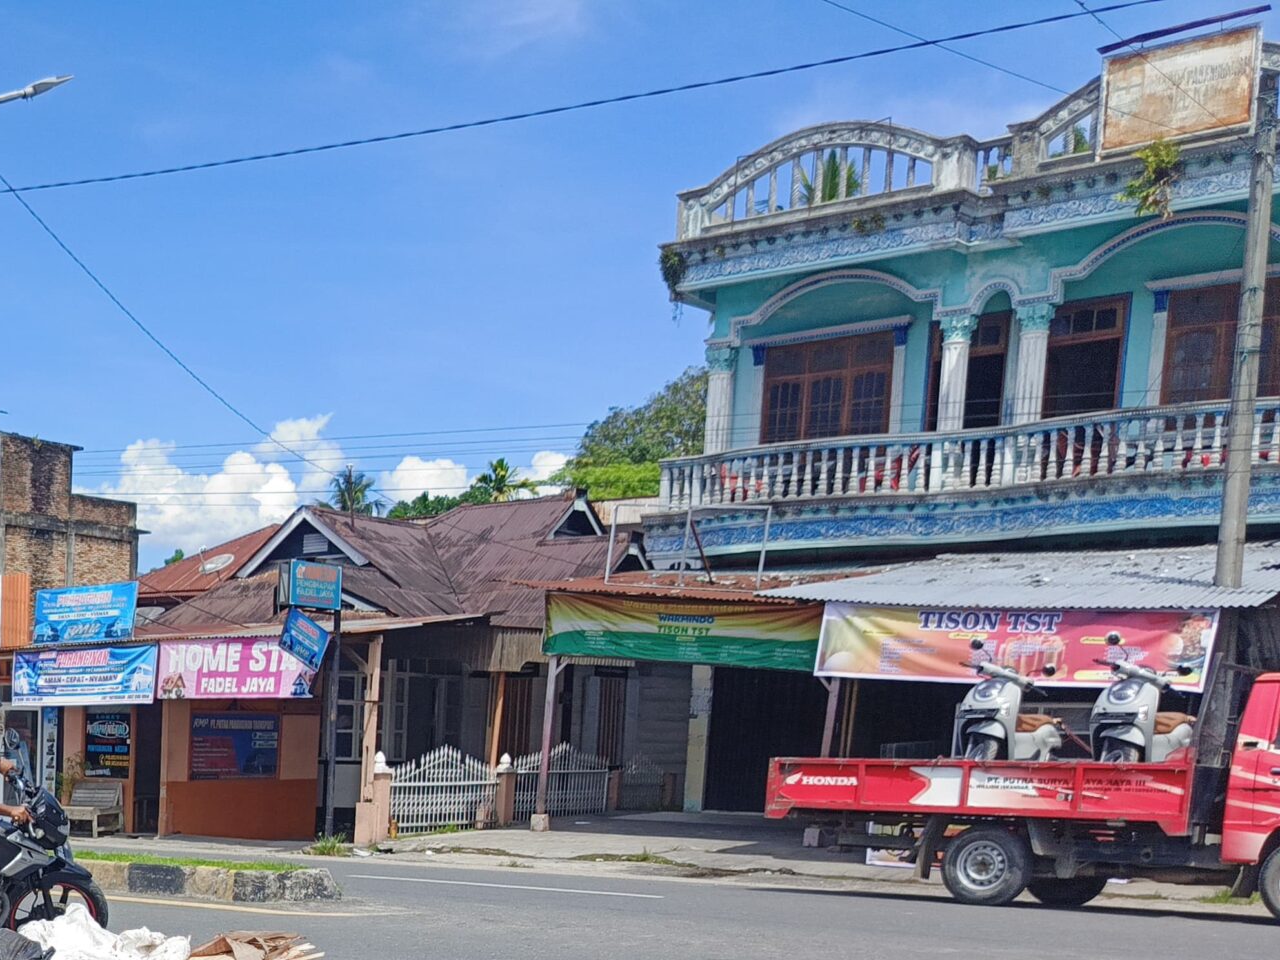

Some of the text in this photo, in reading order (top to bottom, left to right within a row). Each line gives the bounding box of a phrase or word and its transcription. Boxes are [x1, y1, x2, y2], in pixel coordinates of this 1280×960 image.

[918, 611, 1061, 632] TISON TST
[658, 625, 711, 636] TISON TST
[168, 642, 243, 675] HOME
[66, 675, 85, 683] CEPAT
[89, 674, 118, 682] NYAMAN
[200, 676, 276, 694] FADEL JAYA
[801, 775, 858, 787] HONDA
[1002, 777, 1034, 785] PUTRA
